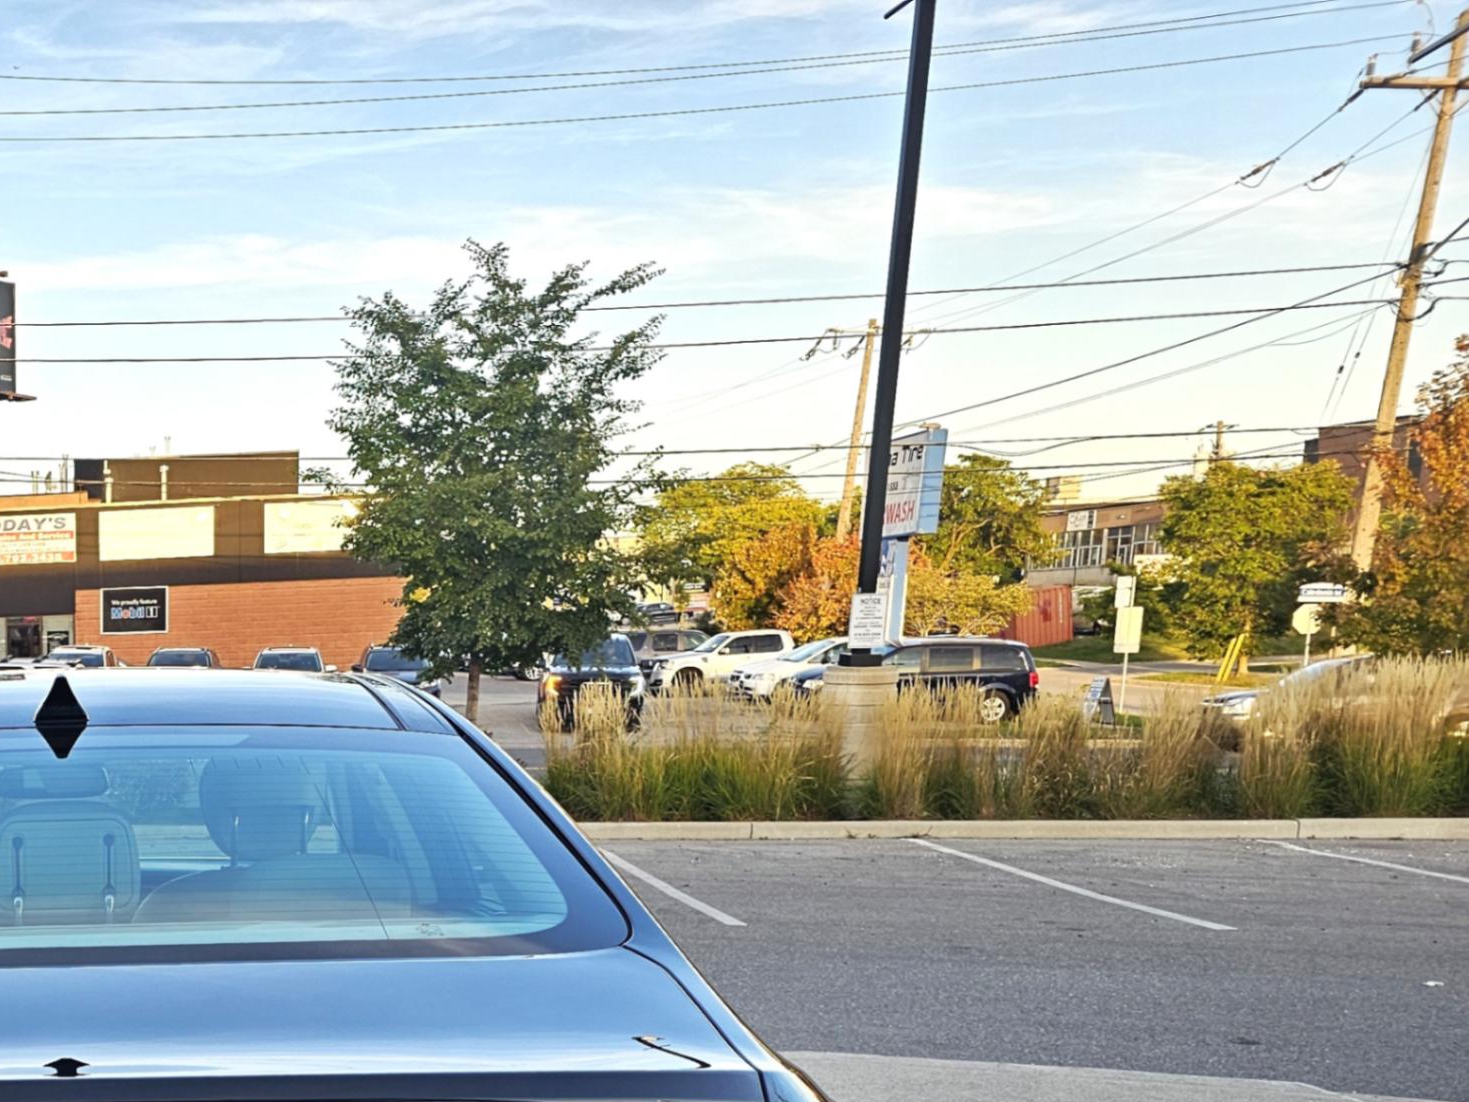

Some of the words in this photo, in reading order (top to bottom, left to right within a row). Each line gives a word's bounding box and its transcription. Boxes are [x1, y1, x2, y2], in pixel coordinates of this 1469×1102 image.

[902, 445, 924, 464] Tire
[885, 500, 915, 525] WASH
[111, 606, 145, 619] Mobil
